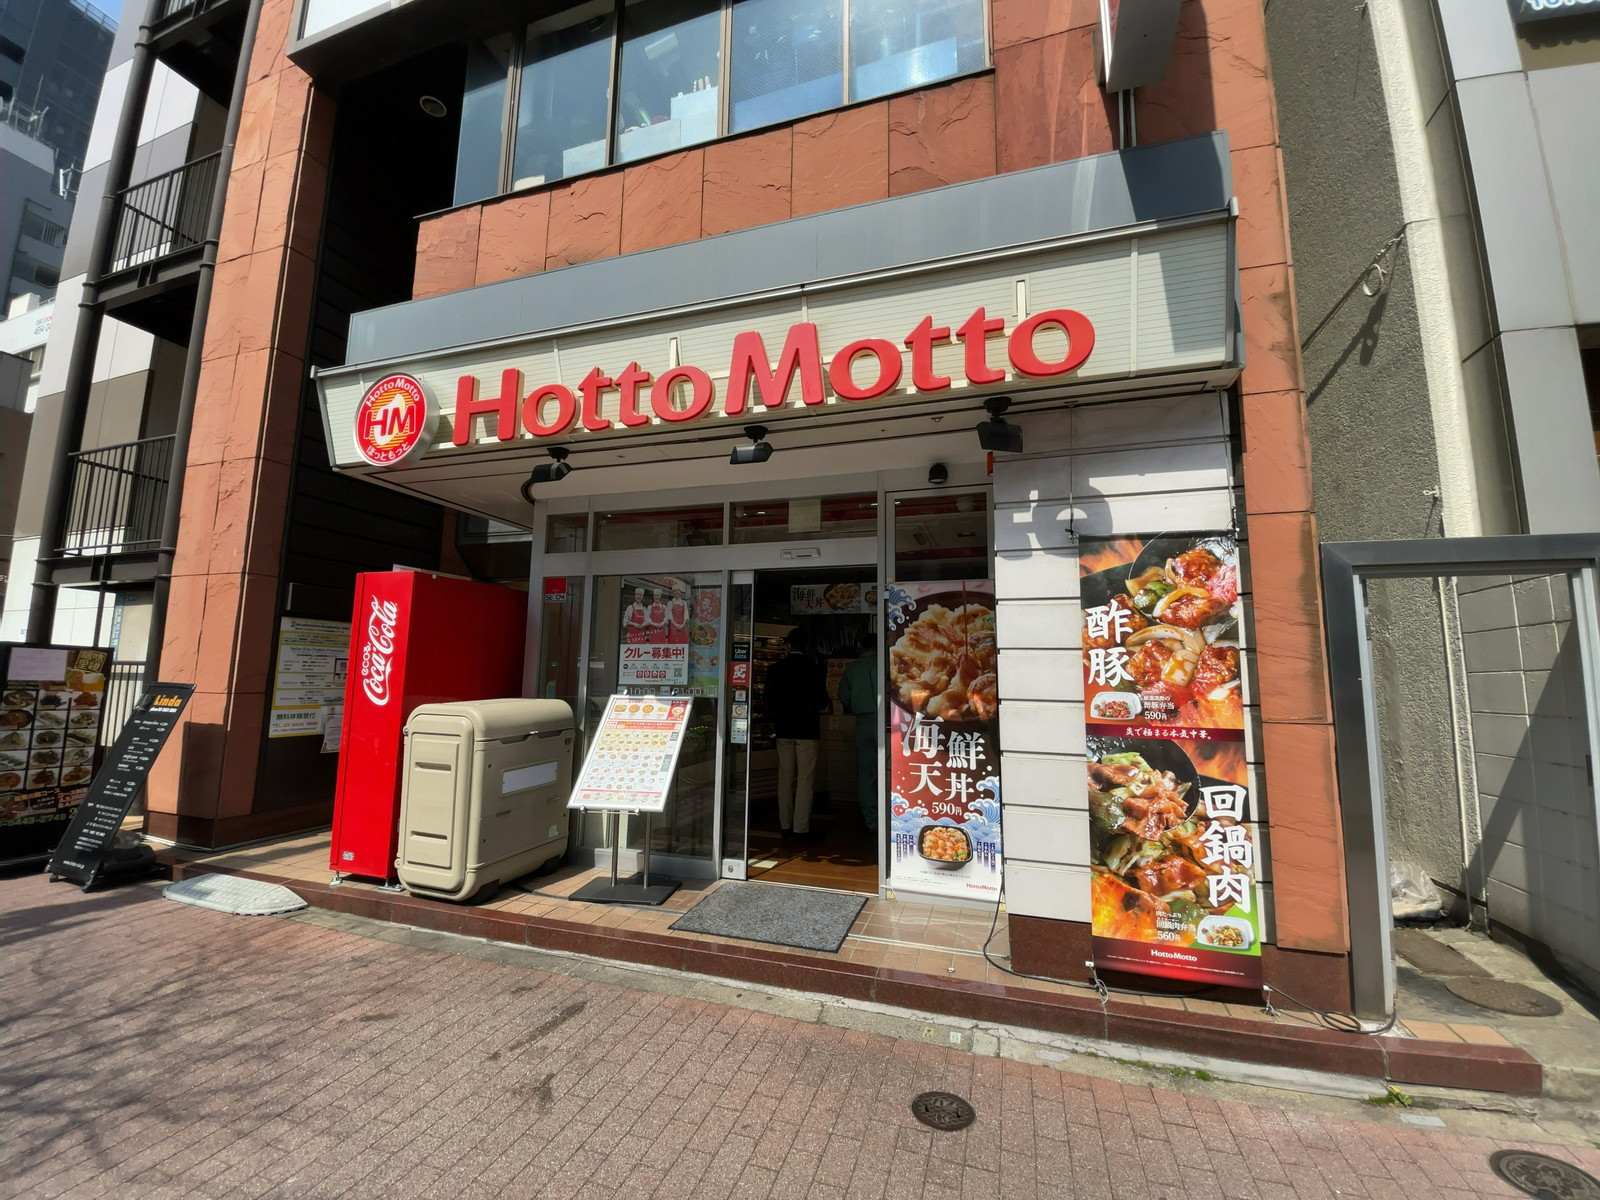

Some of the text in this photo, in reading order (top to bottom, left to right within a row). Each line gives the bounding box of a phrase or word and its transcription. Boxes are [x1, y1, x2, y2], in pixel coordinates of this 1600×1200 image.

[364, 404, 416, 439] HM
[366, 441, 411, 461] ほっともっと
[363, 594, 398, 706] Coca-Cola
[624, 646, 685, 659] クルー募集中!
[1085, 598, 1135, 688] 酢豚
[153, 695, 183, 707] Linda
[1143, 701, 1175, 710] 酢豚弁当
[899, 712, 987, 771] 海鮮
[908, 760, 975, 803] 天丼
[931, 801, 963, 817] 590円
[1199, 784, 1253, 914] 回鍋肉
